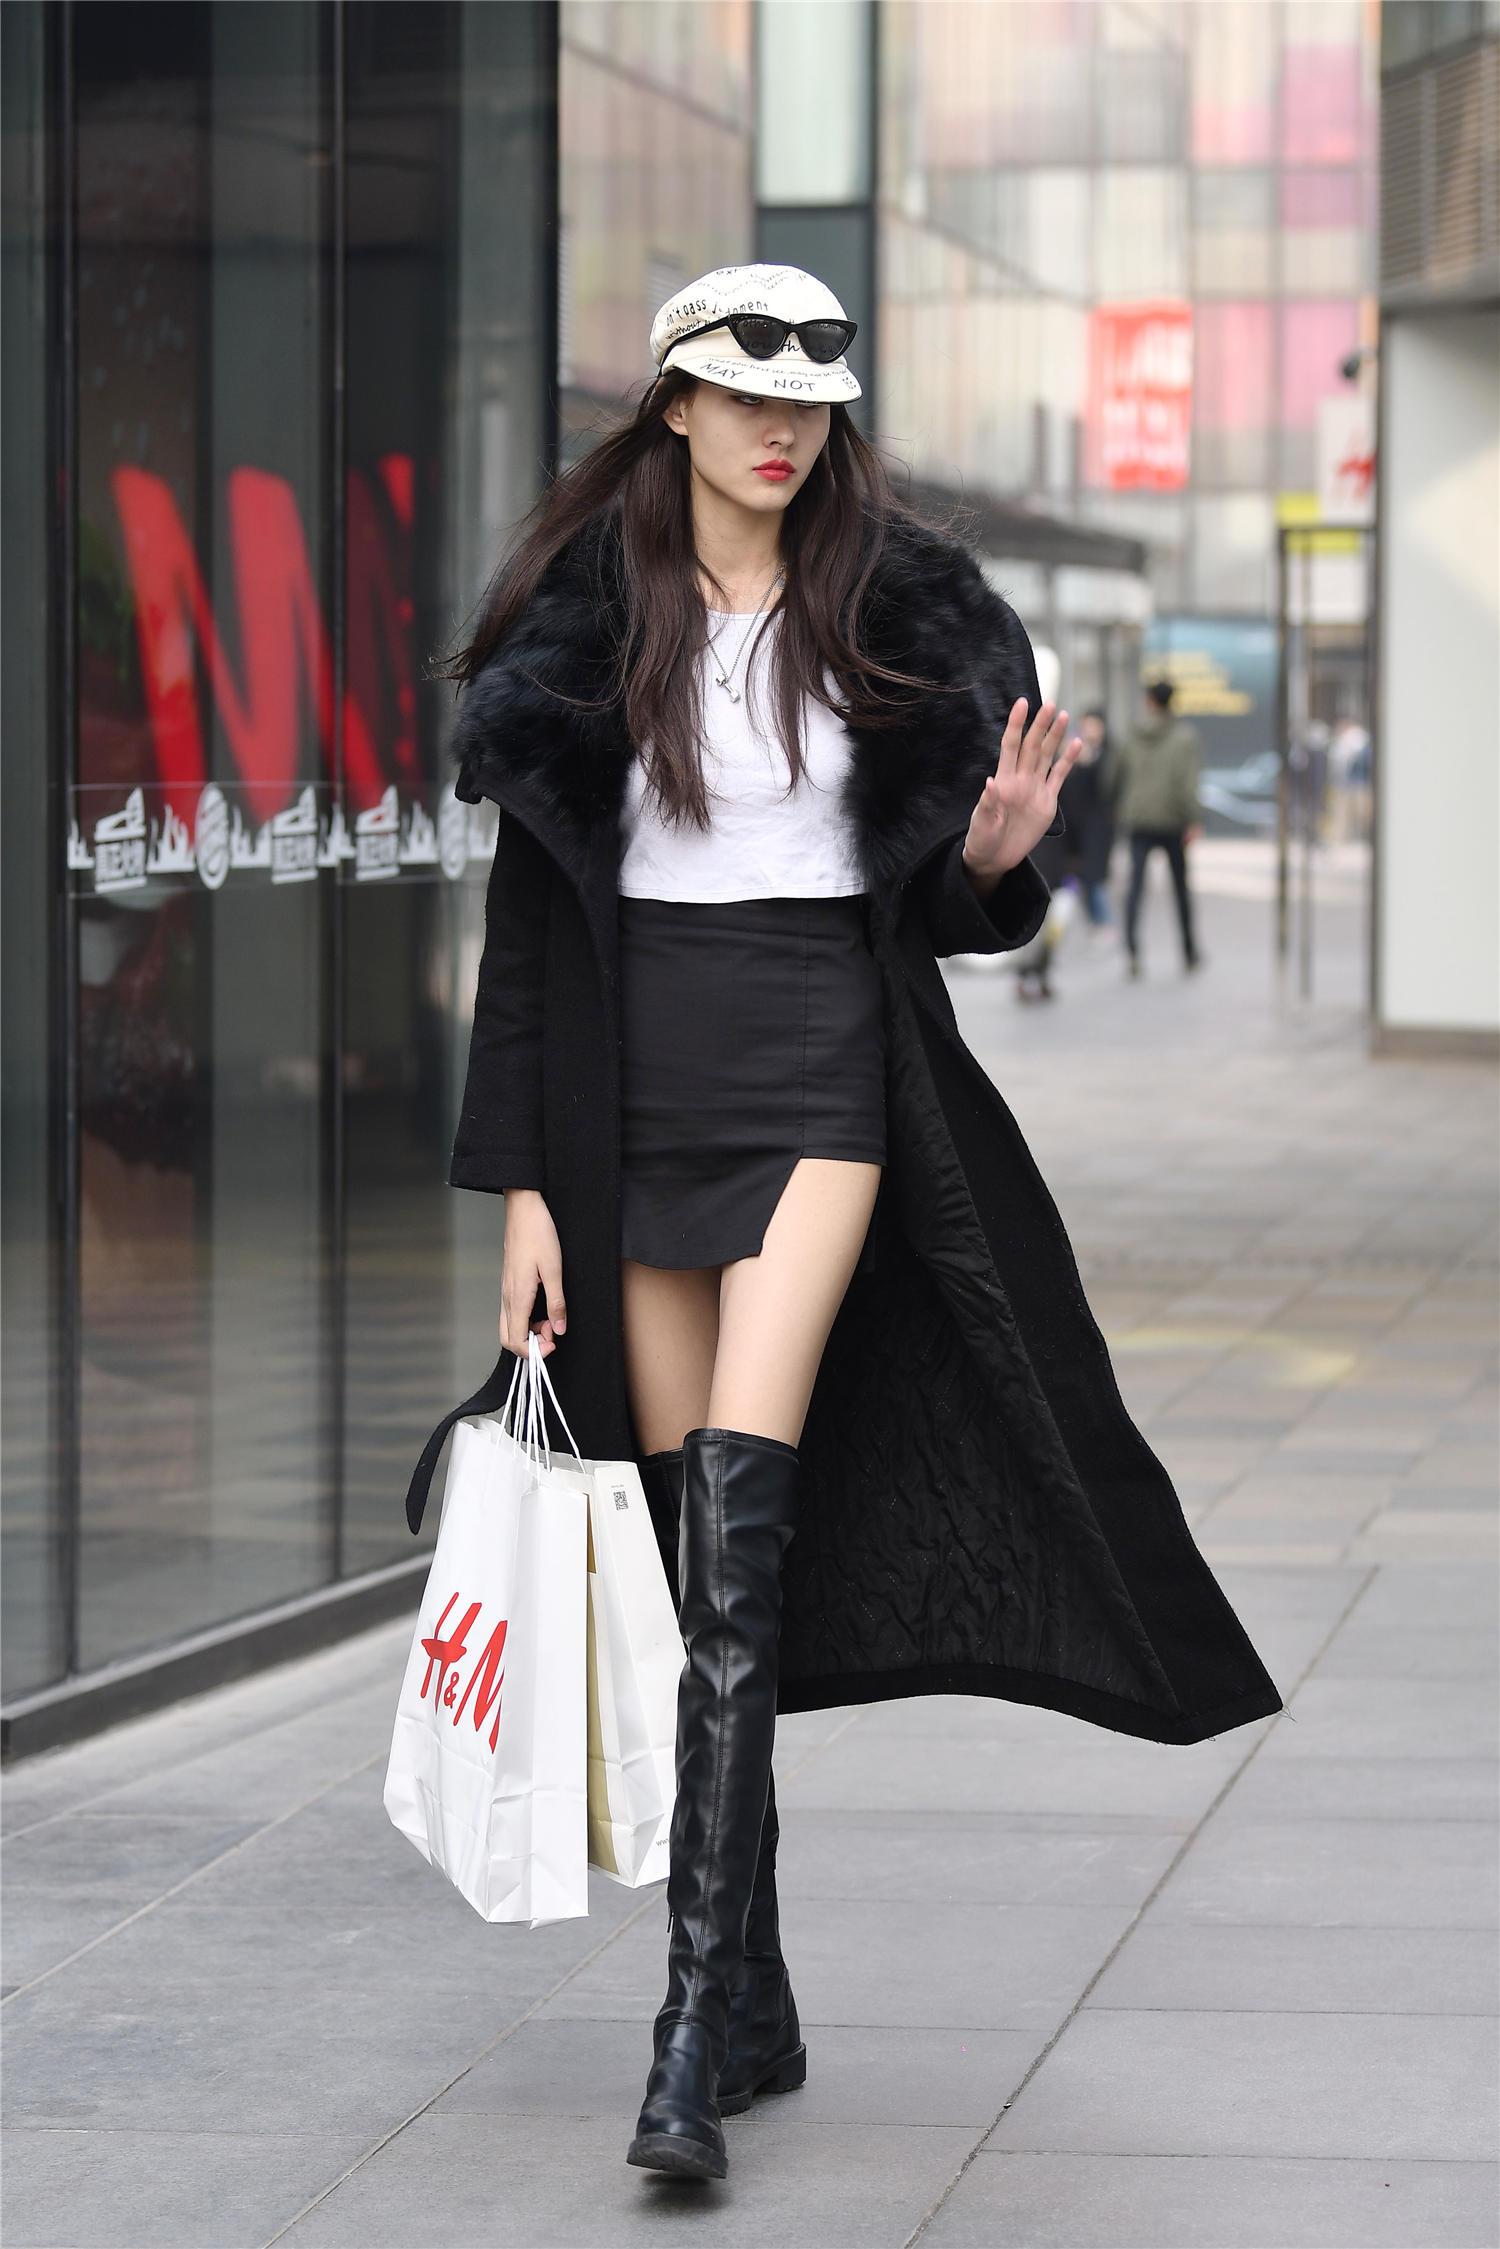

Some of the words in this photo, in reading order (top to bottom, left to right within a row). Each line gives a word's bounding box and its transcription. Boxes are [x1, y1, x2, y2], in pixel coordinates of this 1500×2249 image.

[683, 299, 707, 319] pass
[699, 363, 745, 380] MAY
[774, 378, 817, 392] NOT
[420, 1591, 509, 1755] H&M
